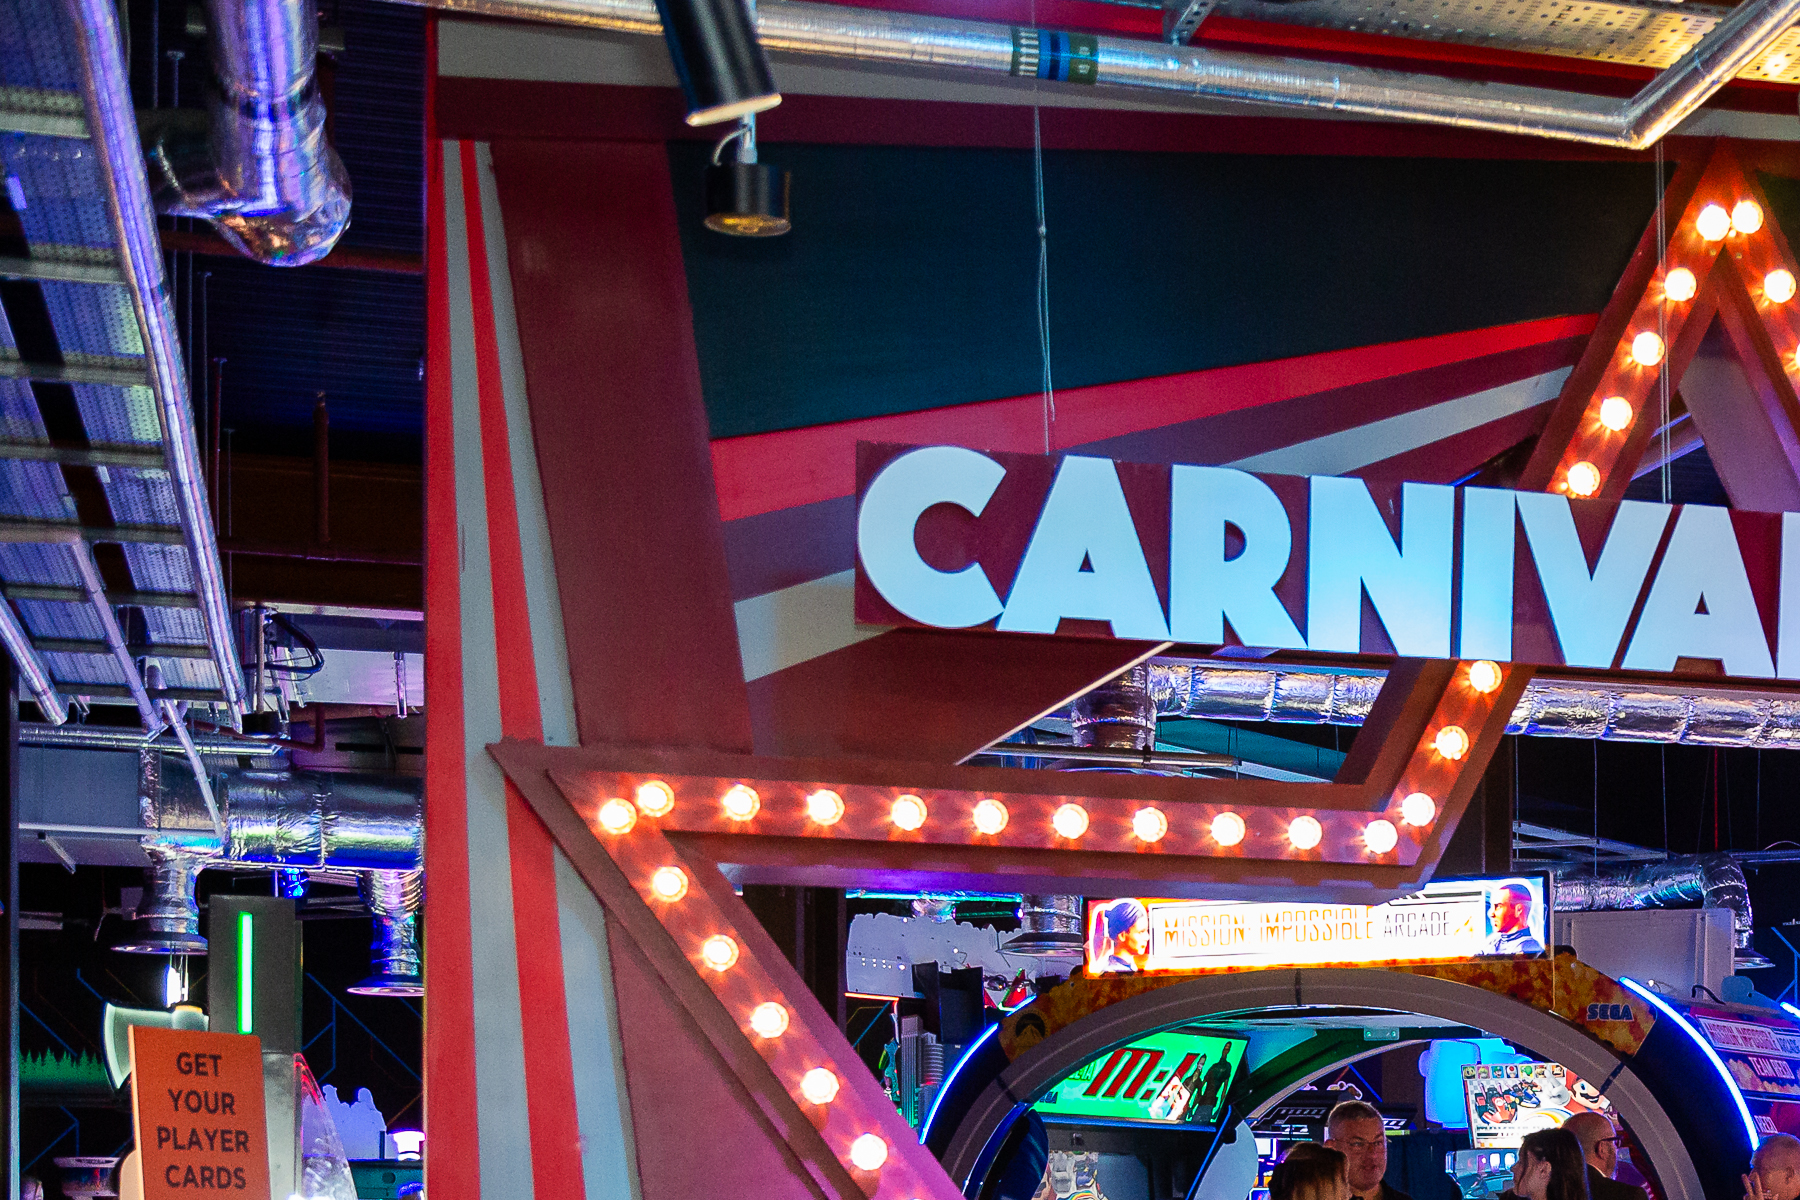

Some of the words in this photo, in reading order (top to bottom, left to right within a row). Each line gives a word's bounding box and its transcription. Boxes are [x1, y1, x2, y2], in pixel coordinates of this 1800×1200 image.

[1260, 905, 1374, 944] IMPOSSIBLE
[1383, 910, 1451, 939] ARCADE
[1586, 1003, 1634, 1022] SEGA
[176, 1051, 222, 1078] GET
[167, 1088, 236, 1116] YOUR
[156, 1125, 250, 1153] PLAYER
[165, 1164, 247, 1190] CARDS
